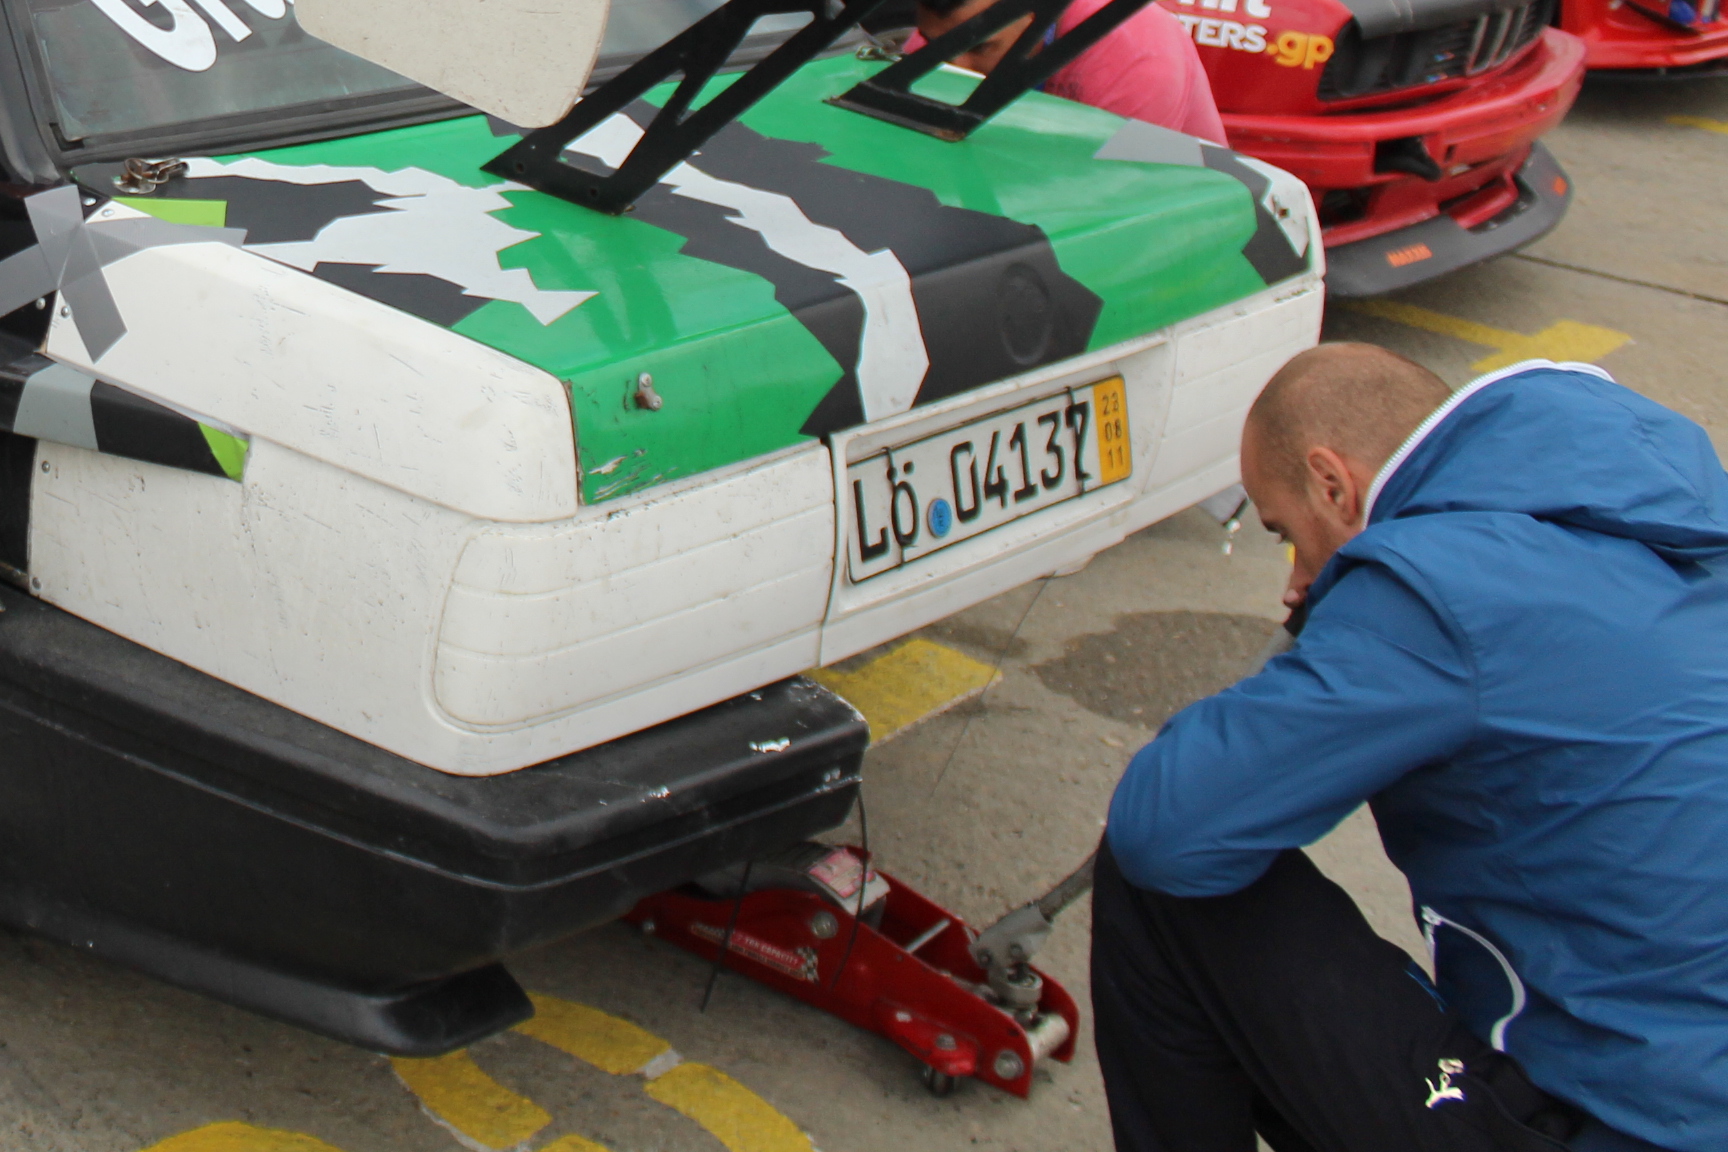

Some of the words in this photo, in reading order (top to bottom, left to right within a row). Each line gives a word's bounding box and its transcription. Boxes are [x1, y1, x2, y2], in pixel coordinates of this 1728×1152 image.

[852, 459, 920, 563] LÖ
[949, 400, 1091, 525] 04137
[1107, 445, 1125, 469] 11
